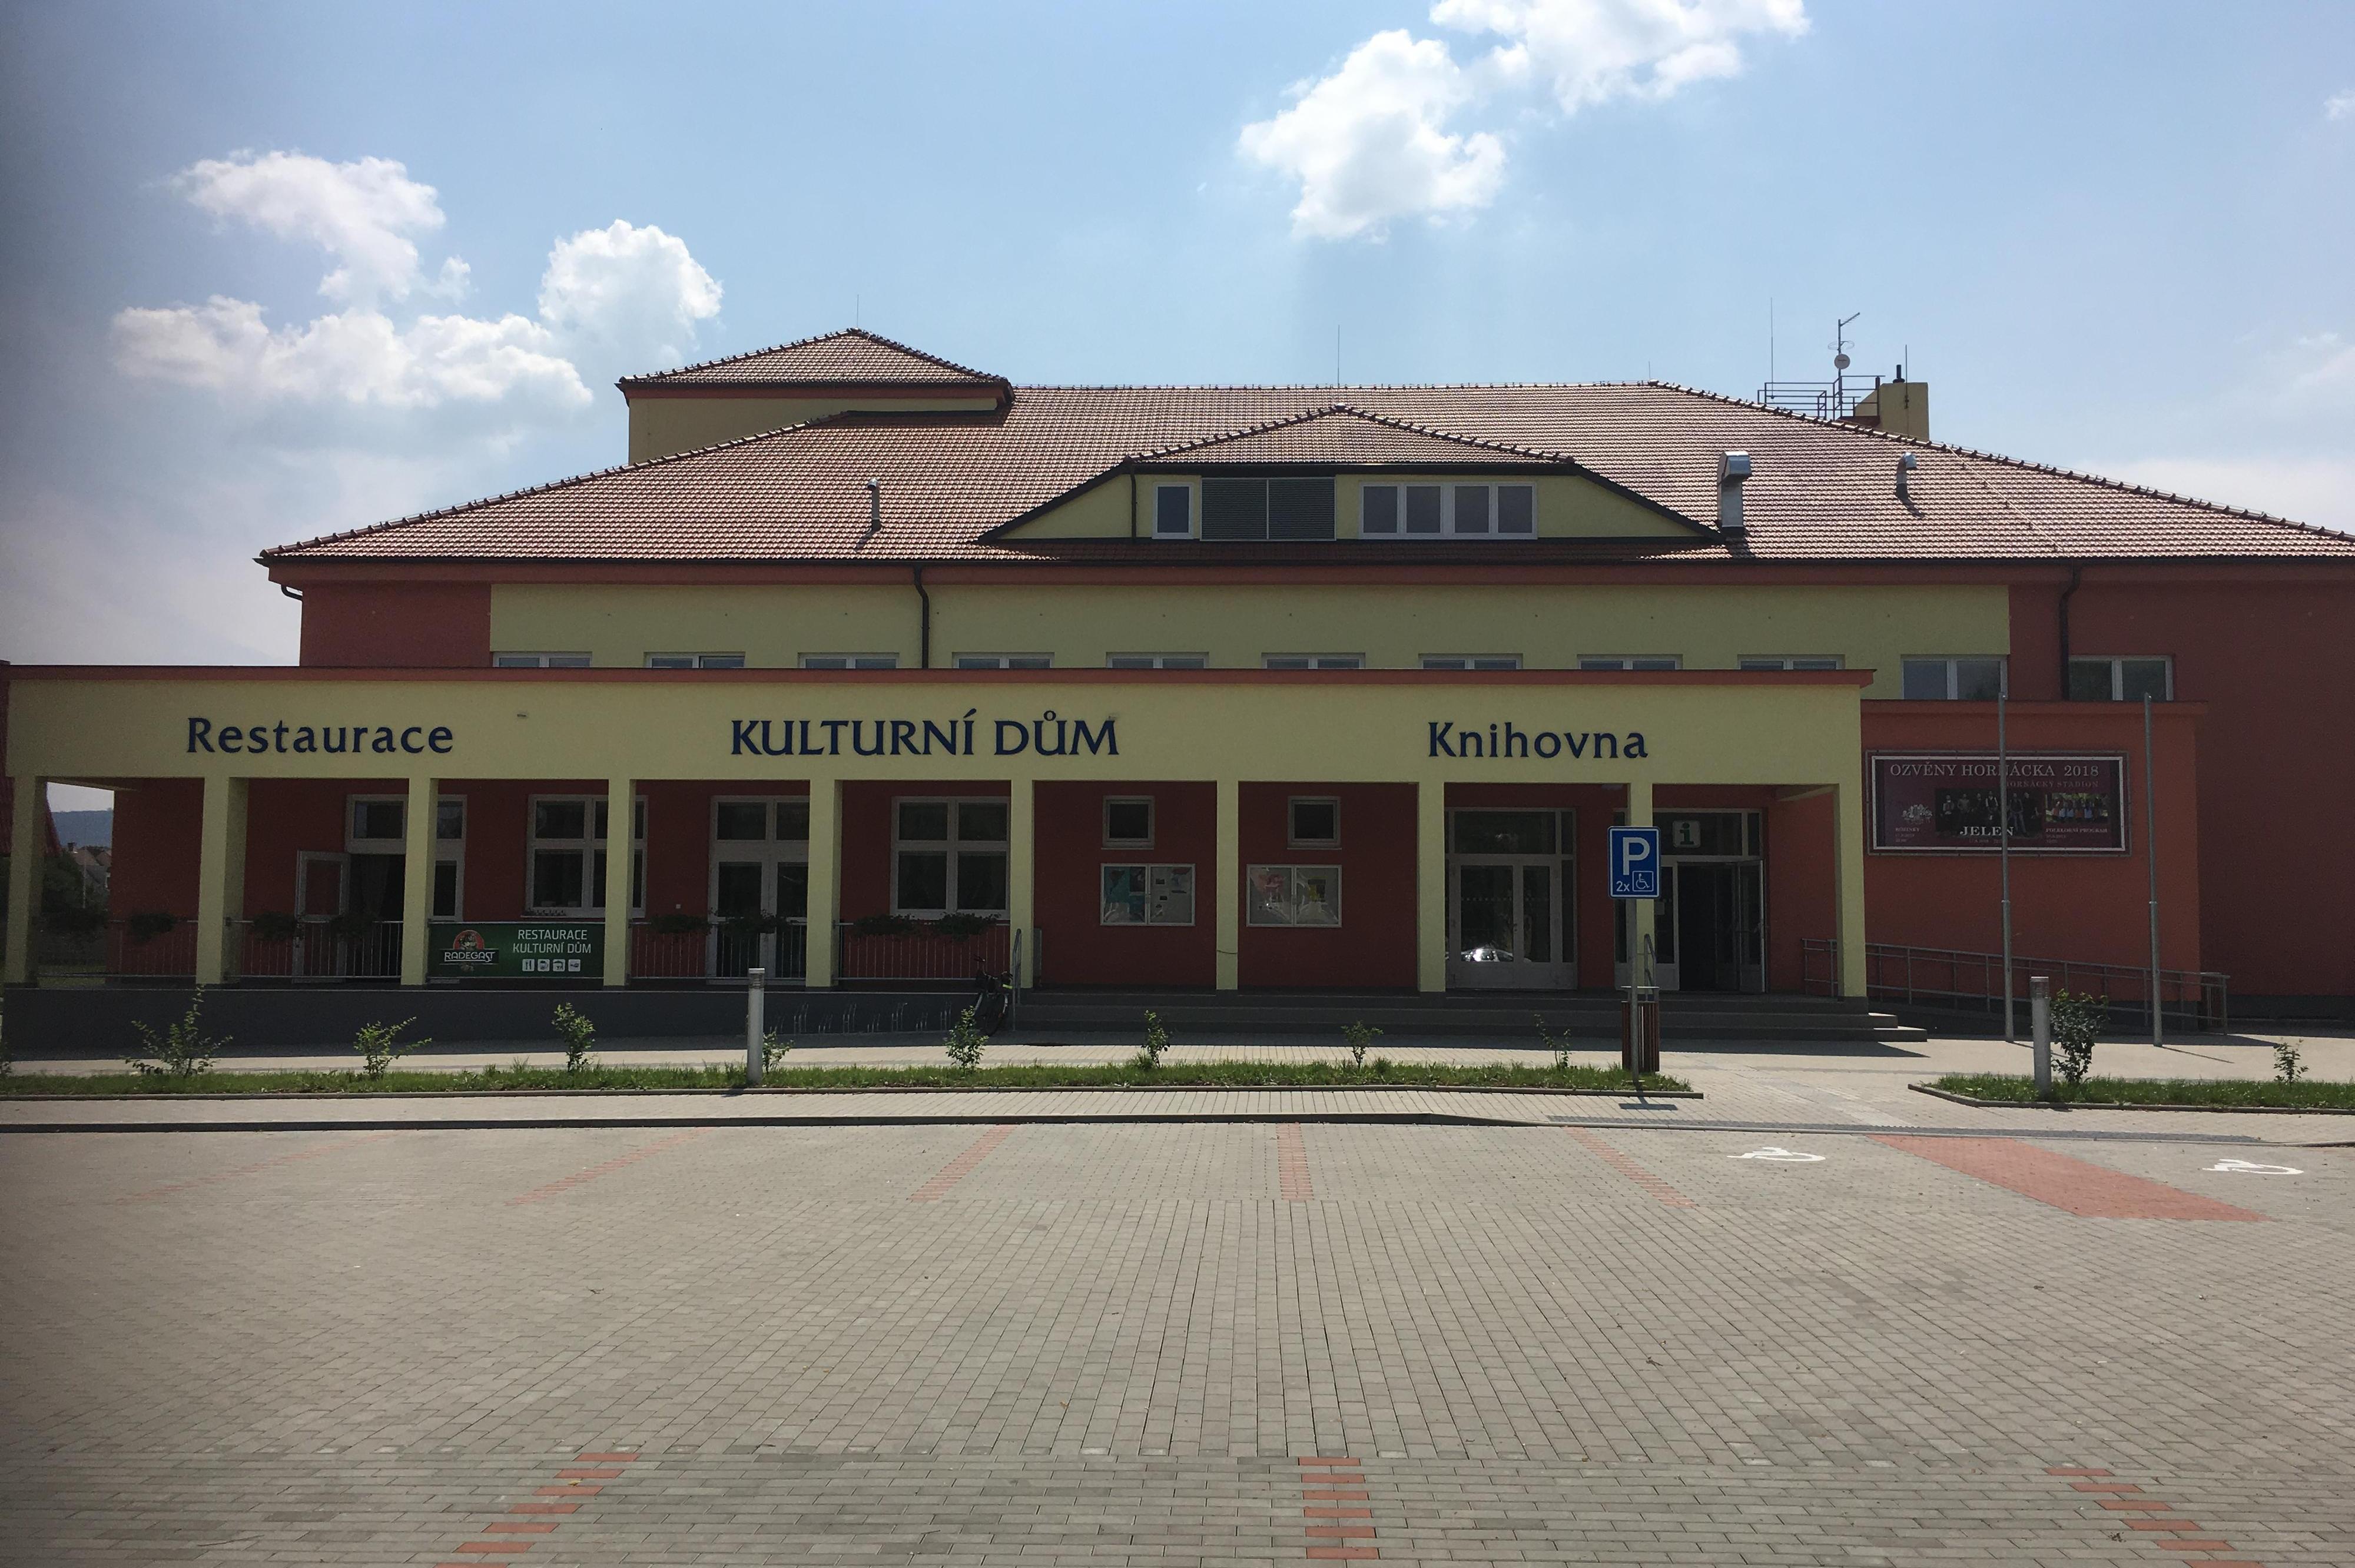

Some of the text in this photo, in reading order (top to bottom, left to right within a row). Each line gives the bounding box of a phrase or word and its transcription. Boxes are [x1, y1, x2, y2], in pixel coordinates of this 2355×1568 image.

[187, 717, 453, 754] Restaurace
[731, 708, 1120, 756] KULTURNÍ DŮM
[1428, 722, 1648, 759] Knihovna
[1890, 762, 1956, 777] OZVĚNY
[2064, 765, 2099, 777] 2018
[1622, 836, 1650, 876] P
[1616, 881, 1630, 892] 2x
[518, 929, 588, 940] RESTAURACE
[512, 941, 591, 954] KULTURNÍ DŮM
[444, 951, 495, 962] RADEGAST
